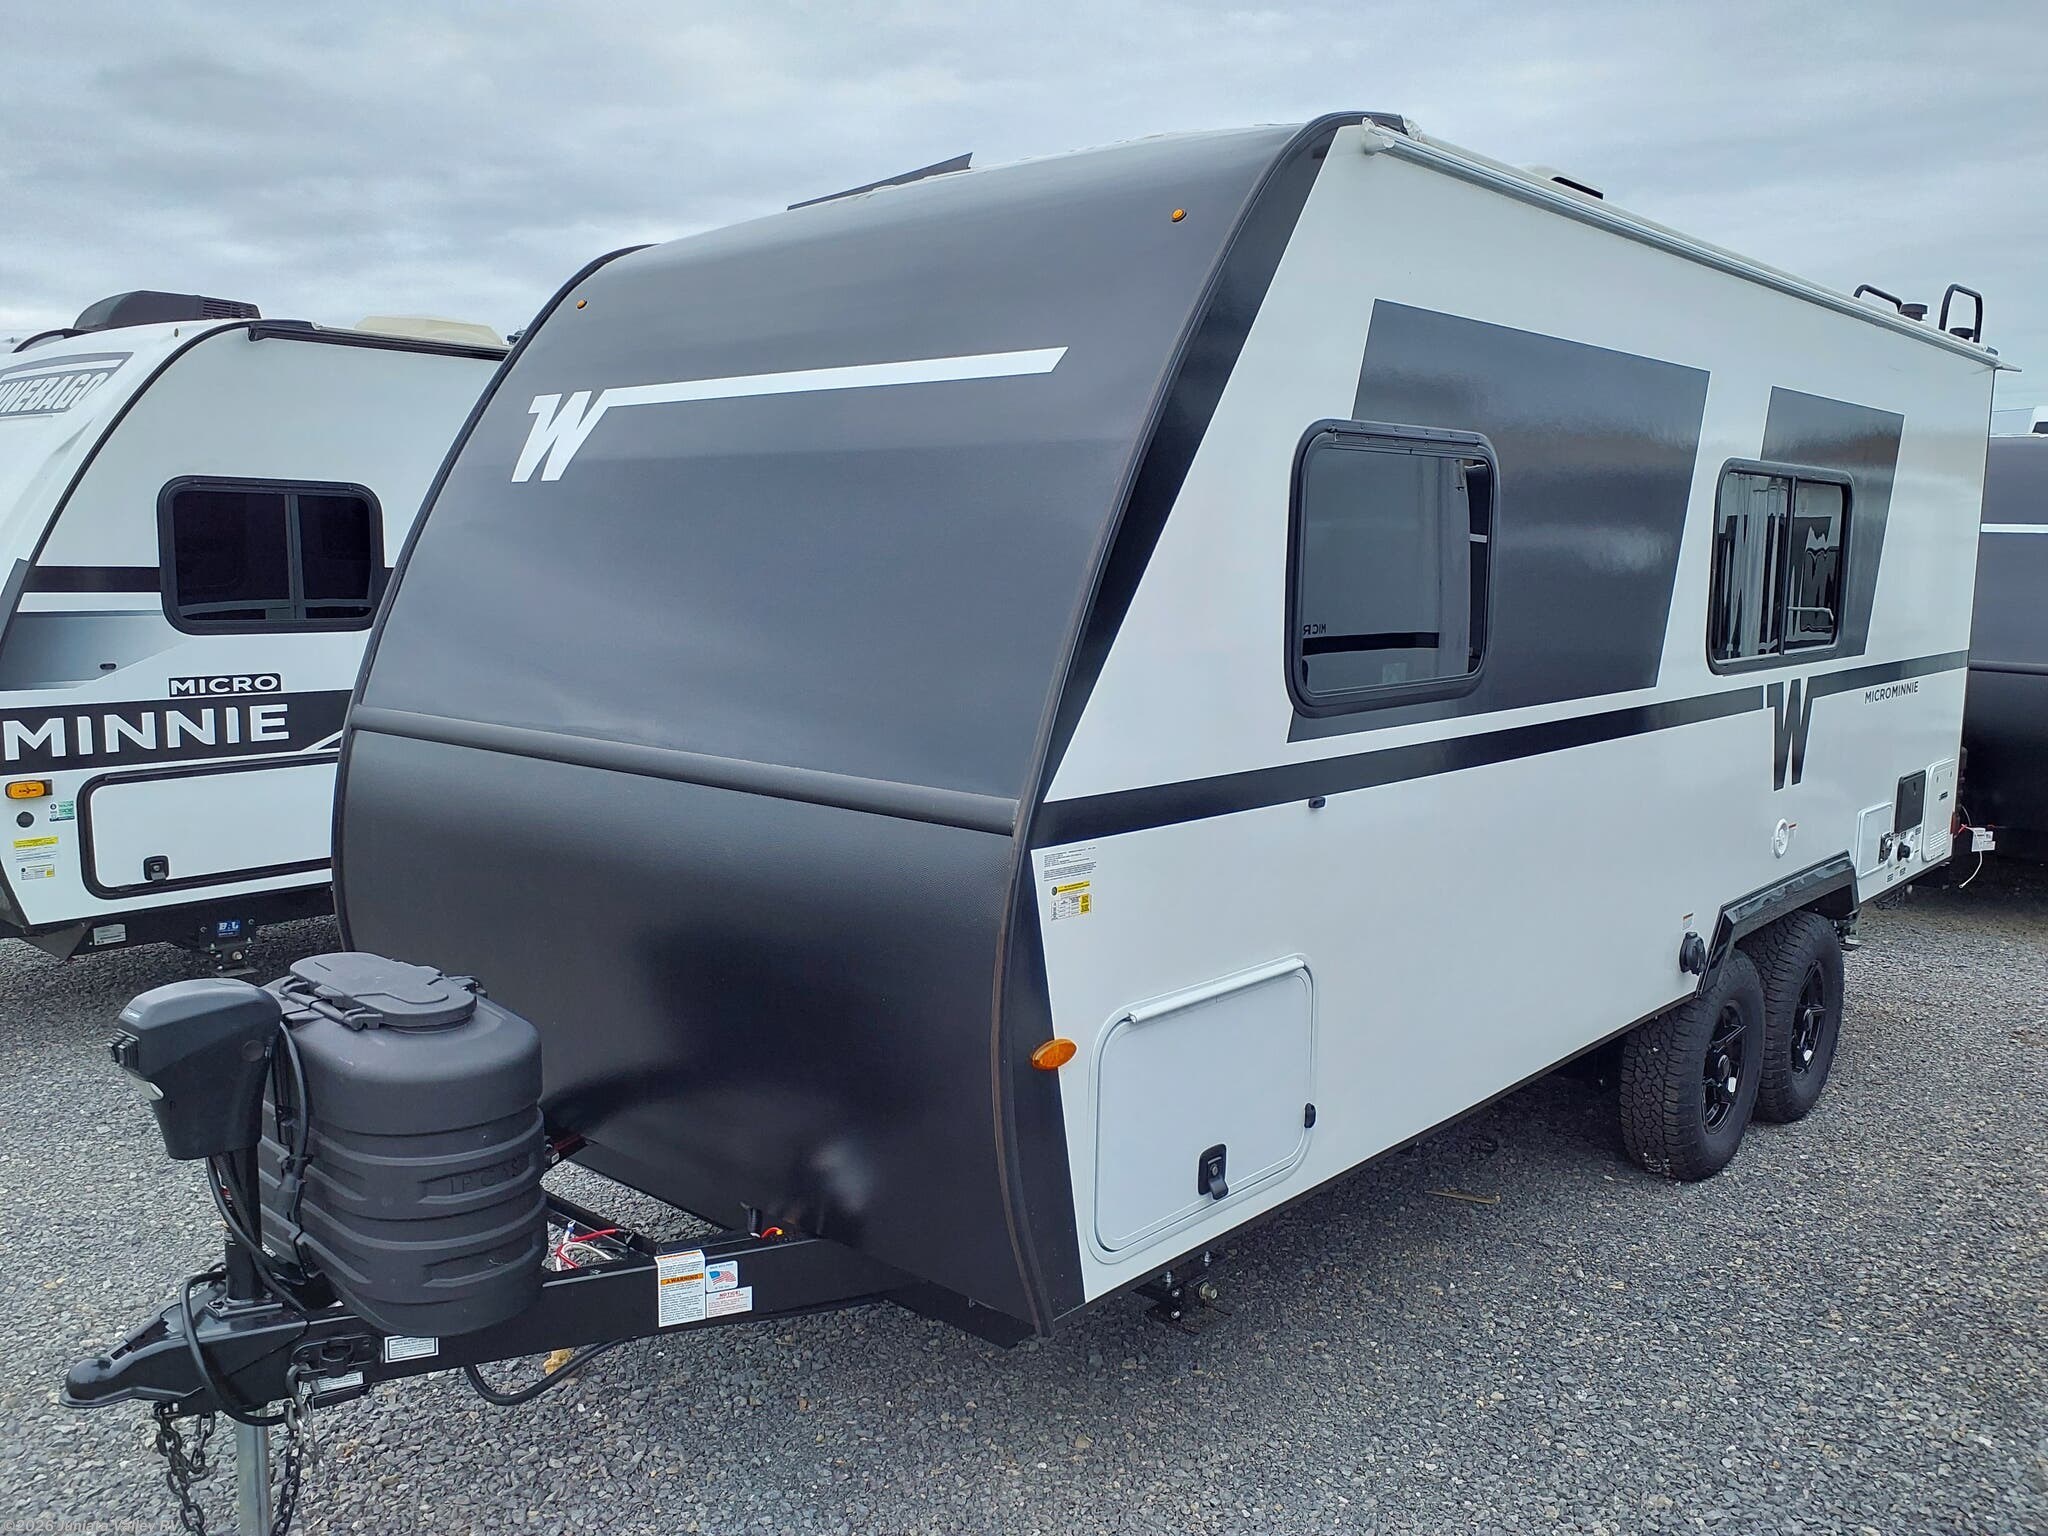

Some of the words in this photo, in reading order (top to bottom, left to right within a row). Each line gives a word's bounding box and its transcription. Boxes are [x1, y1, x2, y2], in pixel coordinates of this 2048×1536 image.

[170, 675, 279, 696] MICRO
[1864, 681, 1919, 704] MICROMINNIE
[2, 703, 290, 761] MINNIE
